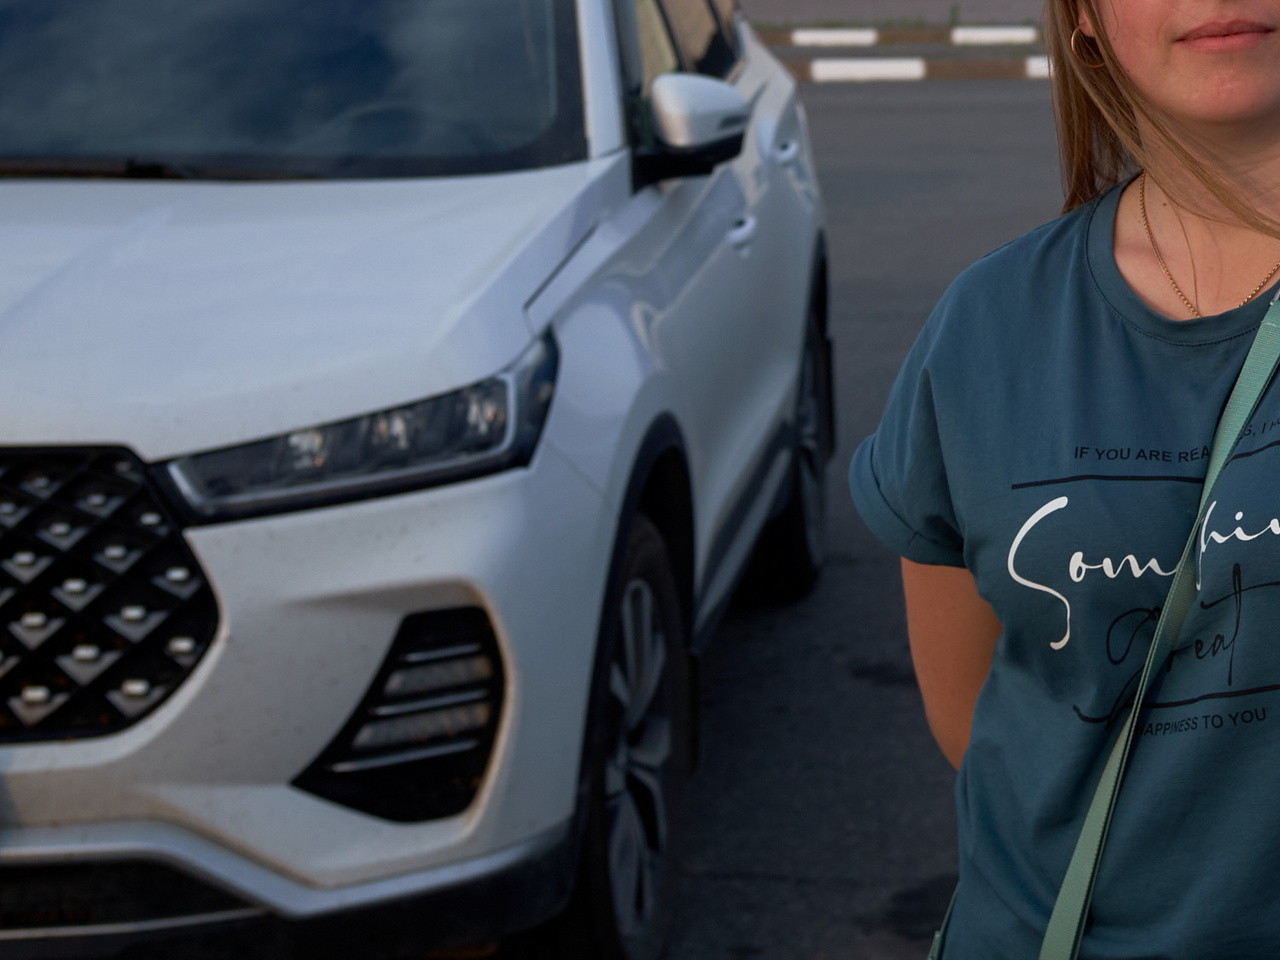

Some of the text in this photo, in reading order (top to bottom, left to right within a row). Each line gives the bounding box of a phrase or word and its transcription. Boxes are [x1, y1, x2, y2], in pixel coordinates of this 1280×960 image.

[1074, 446, 1089, 459] IF
[1095, 448, 1131, 460] YOU
[1136, 449, 1172, 462] ARE
[1202, 714, 1224, 729] TO
[1228, 707, 1267, 726] YOU
